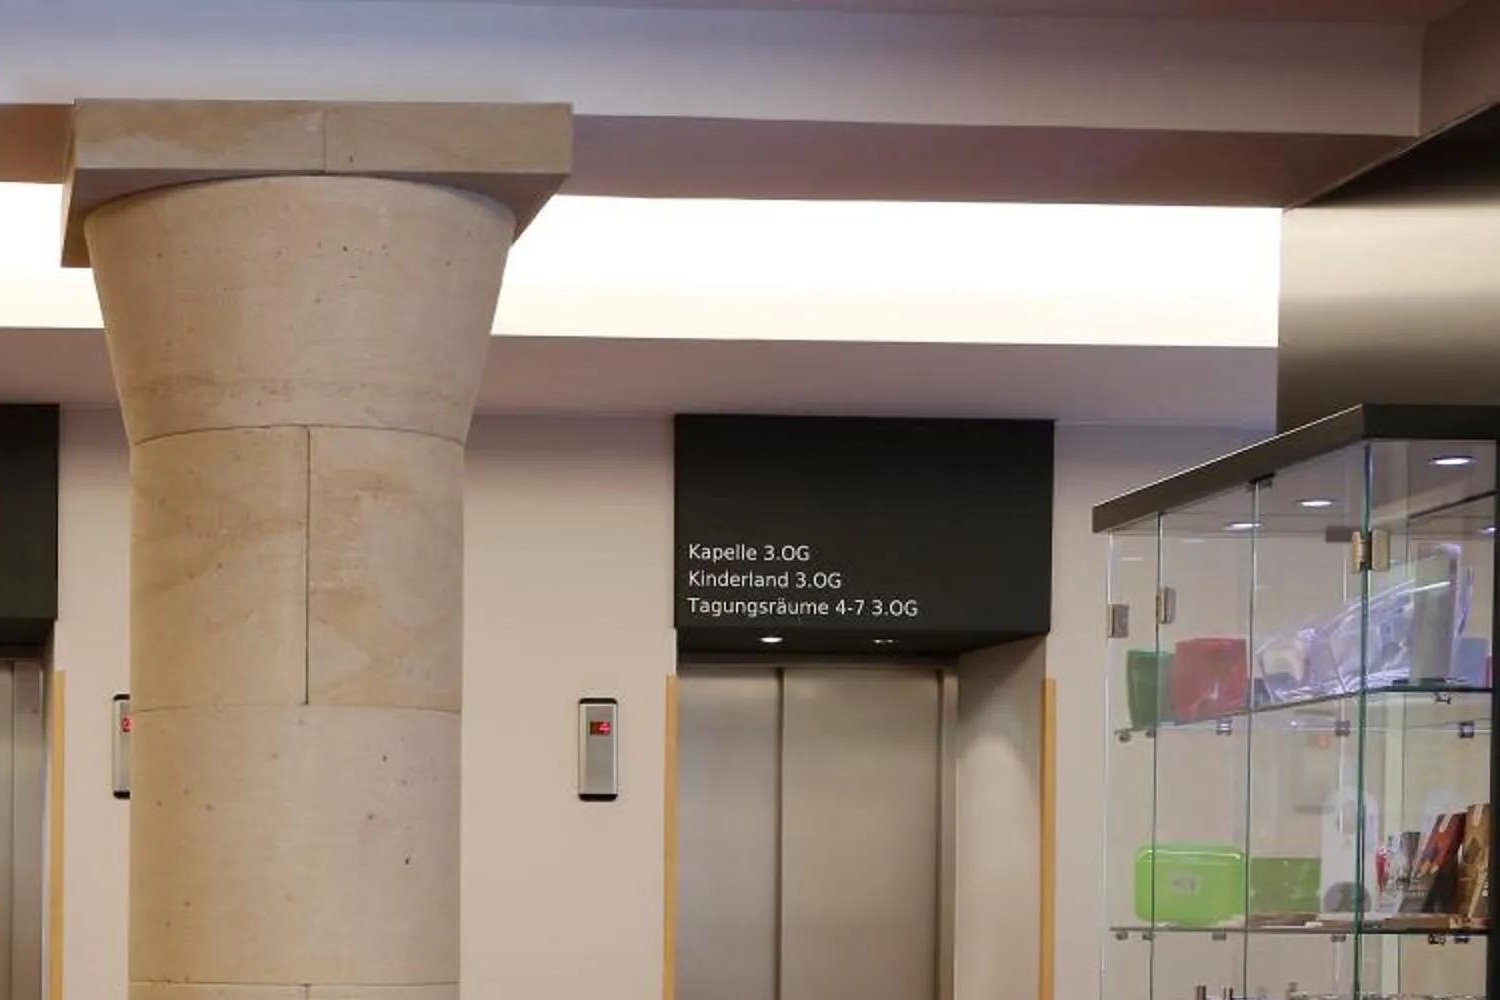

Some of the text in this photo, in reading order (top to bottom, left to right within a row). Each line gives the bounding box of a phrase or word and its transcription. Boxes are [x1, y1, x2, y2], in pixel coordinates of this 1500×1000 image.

[688, 543, 810, 563] Kapelle 3.OG
[688, 570, 842, 588] Kinderland 3.OG
[687, 597, 919, 617] Tagungsräume 4-7 3.OG
